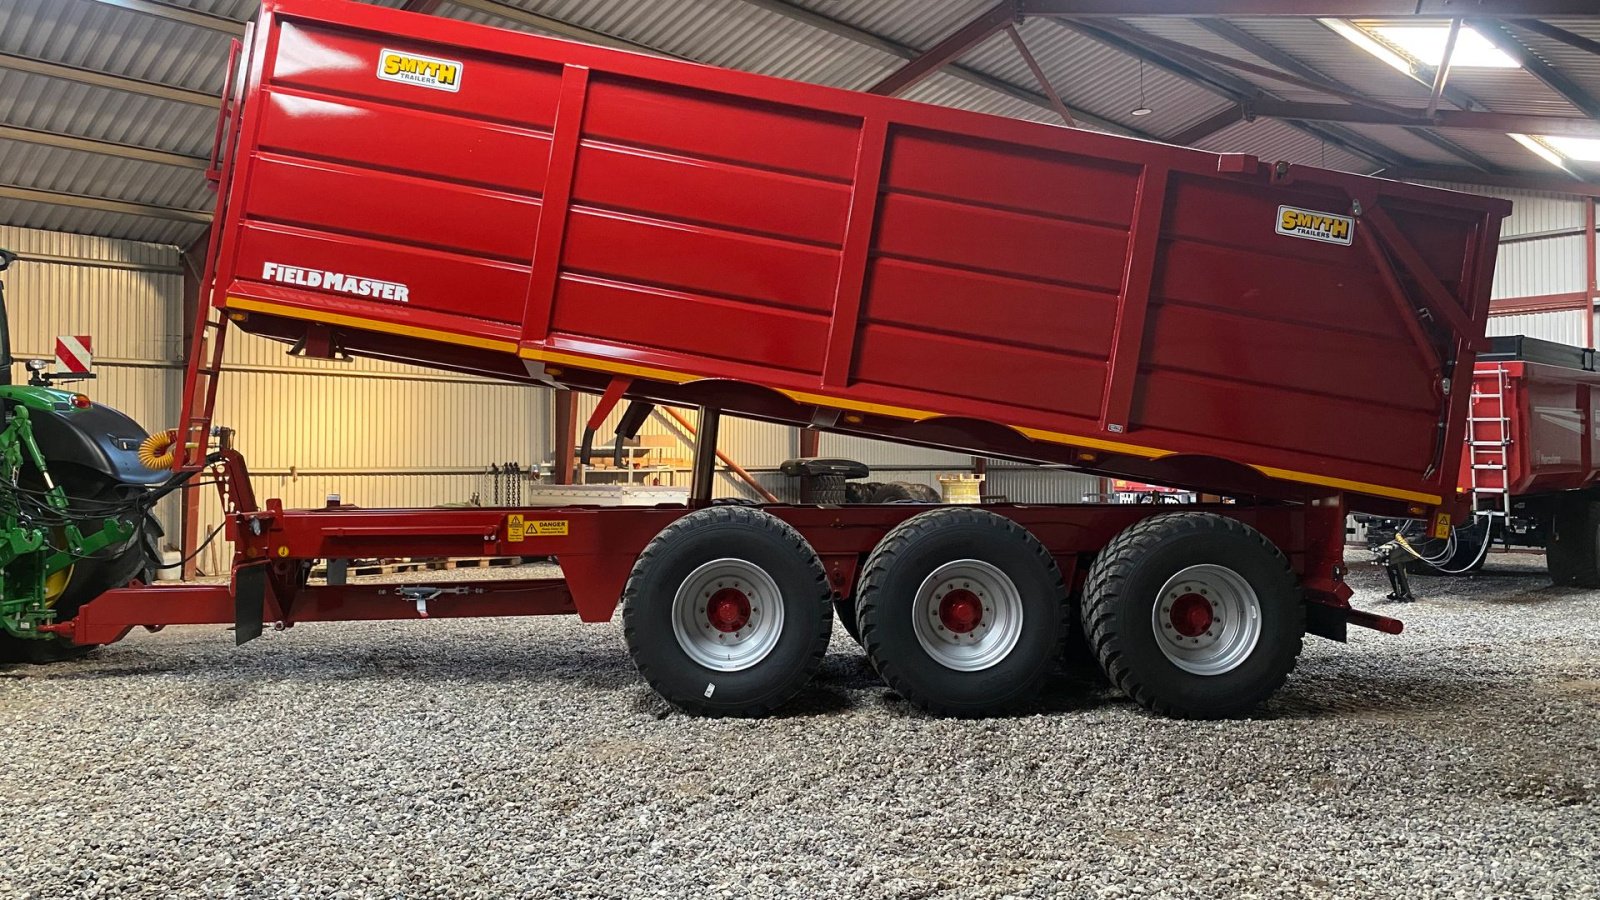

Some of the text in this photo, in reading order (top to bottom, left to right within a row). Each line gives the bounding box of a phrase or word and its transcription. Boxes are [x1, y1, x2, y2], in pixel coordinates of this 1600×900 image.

[384, 54, 456, 85] SMYTH
[400, 72, 436, 85] TRAILERS
[1282, 210, 1350, 240] SMYTH
[1297, 228, 1330, 239] TRAILERS
